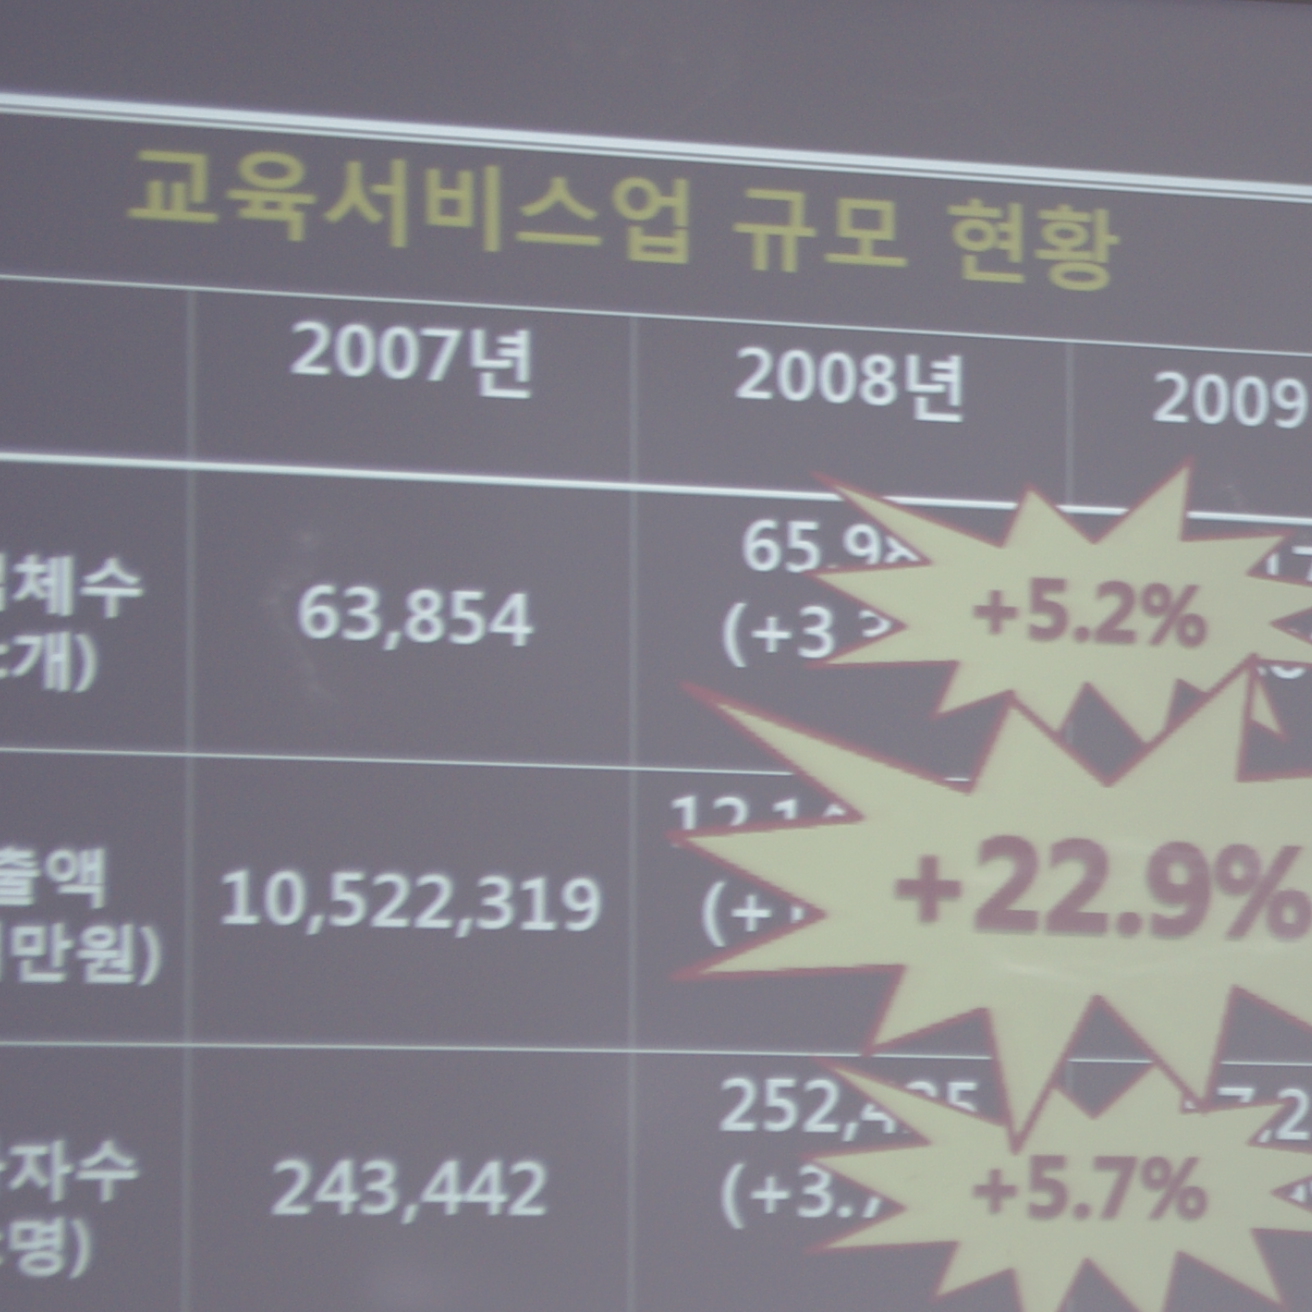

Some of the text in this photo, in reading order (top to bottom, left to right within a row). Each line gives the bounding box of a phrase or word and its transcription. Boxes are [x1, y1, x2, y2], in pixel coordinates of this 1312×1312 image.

[126, 147, 1121, 293] 교육서비스업 규모 현황
[290, 320, 534, 400] 2007년
[735, 345, 964, 424] 2008년
[0, 552, 145, 620] 체수
[300, 584, 535, 651] 63,854
[972, 575, 1209, 648] +5.2%
[220, 869, 603, 938] 10,522,319
[0, 921, 163, 987] 만원)
[0, 1138, 141, 1203] 자수
[270, 1158, 549, 1225] 243,442
[972, 1153, 1209, 1222] +5.7%
[0, 1216, 92, 1281] 명)
